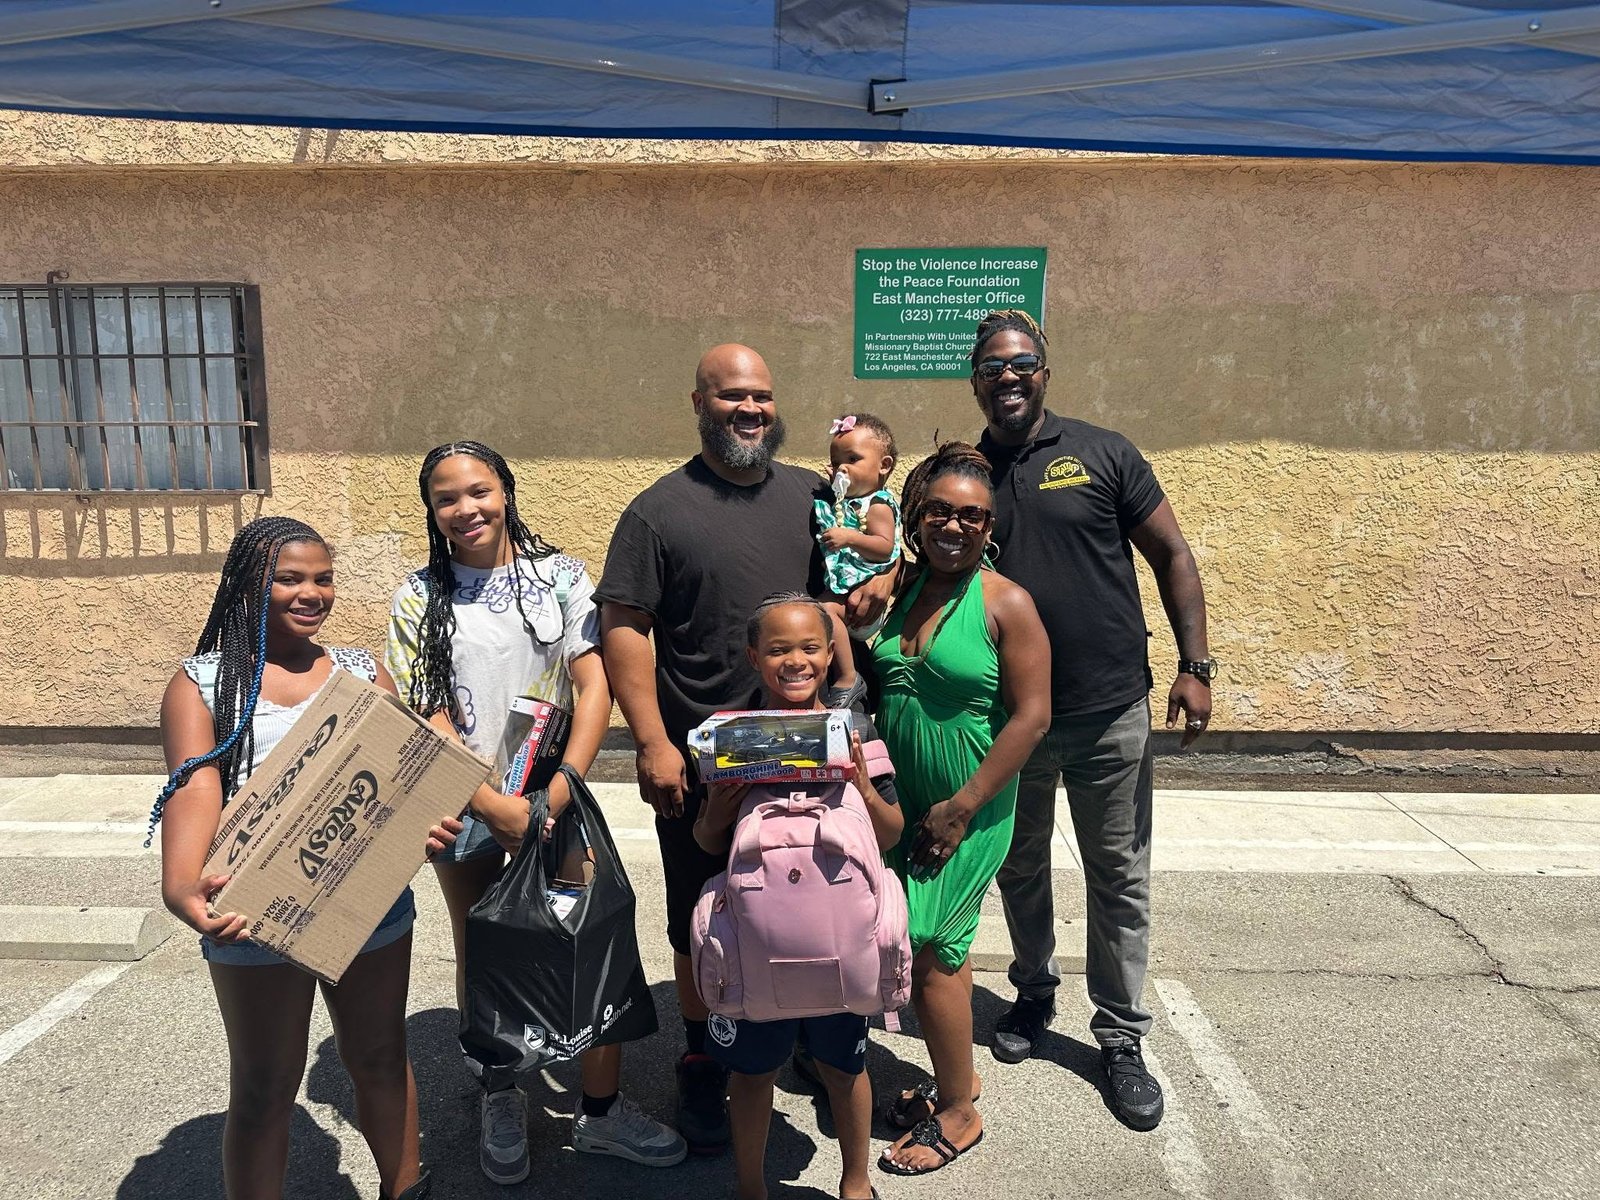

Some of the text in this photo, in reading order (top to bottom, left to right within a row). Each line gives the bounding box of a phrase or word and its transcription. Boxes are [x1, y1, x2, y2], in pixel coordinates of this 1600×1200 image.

[863, 258, 1038, 272] Stop the Violence Increase
[879, 275, 1020, 288] the Peace Foundation
[873, 292, 1025, 304] East Manchester Office
[900, 309, 933, 324] (323)
[876, 332, 926, 342] Partnership
[927, 332, 946, 340] With
[865, 343, 912, 353] Missionary
[912, 343, 944, 352] Baptist
[882, 363, 919, 372] Angeles,
[936, 362, 961, 370] 90001
[396, 743, 409, 755] BOX
[336, 743, 362, 772] DISTRIBUTED
[331, 770, 340, 778] BY
[250, 820, 275, 850] 28000
[276, 839, 285, 847] VA
[262, 895, 284, 919] 75624
[270, 894, 296, 923] 0 28000
[248, 919, 265, 936] 600
[562, 1024, 592, 1045] Louise
